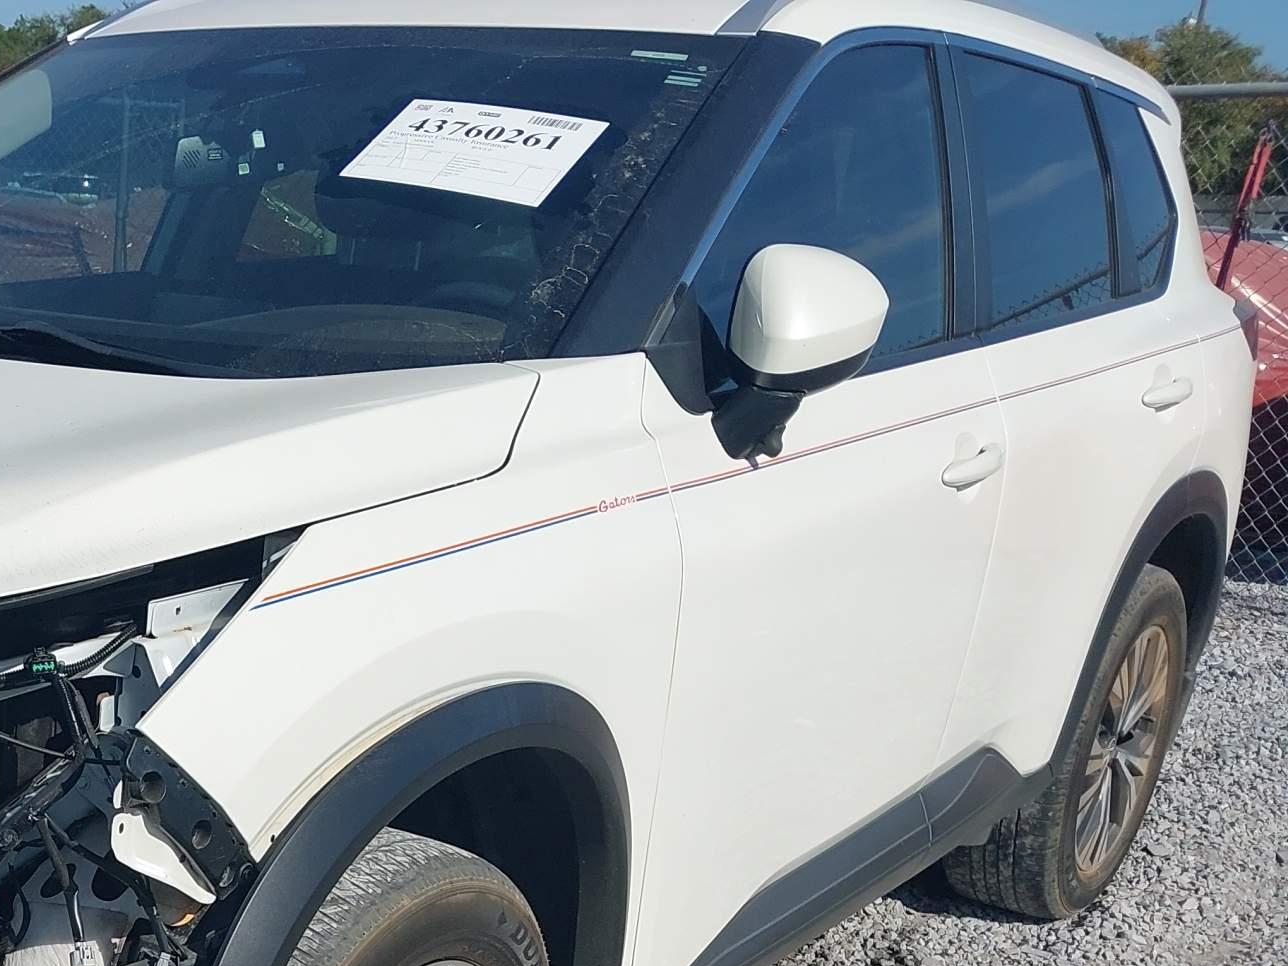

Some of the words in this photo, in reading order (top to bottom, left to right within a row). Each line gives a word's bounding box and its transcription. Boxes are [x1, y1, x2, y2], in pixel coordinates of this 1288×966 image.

[389, 130, 434, 140] Progressive
[470, 138, 510, 150] Insurance
[408, 117, 563, 151] 43760261
[598, 495, 636, 512] Gators
